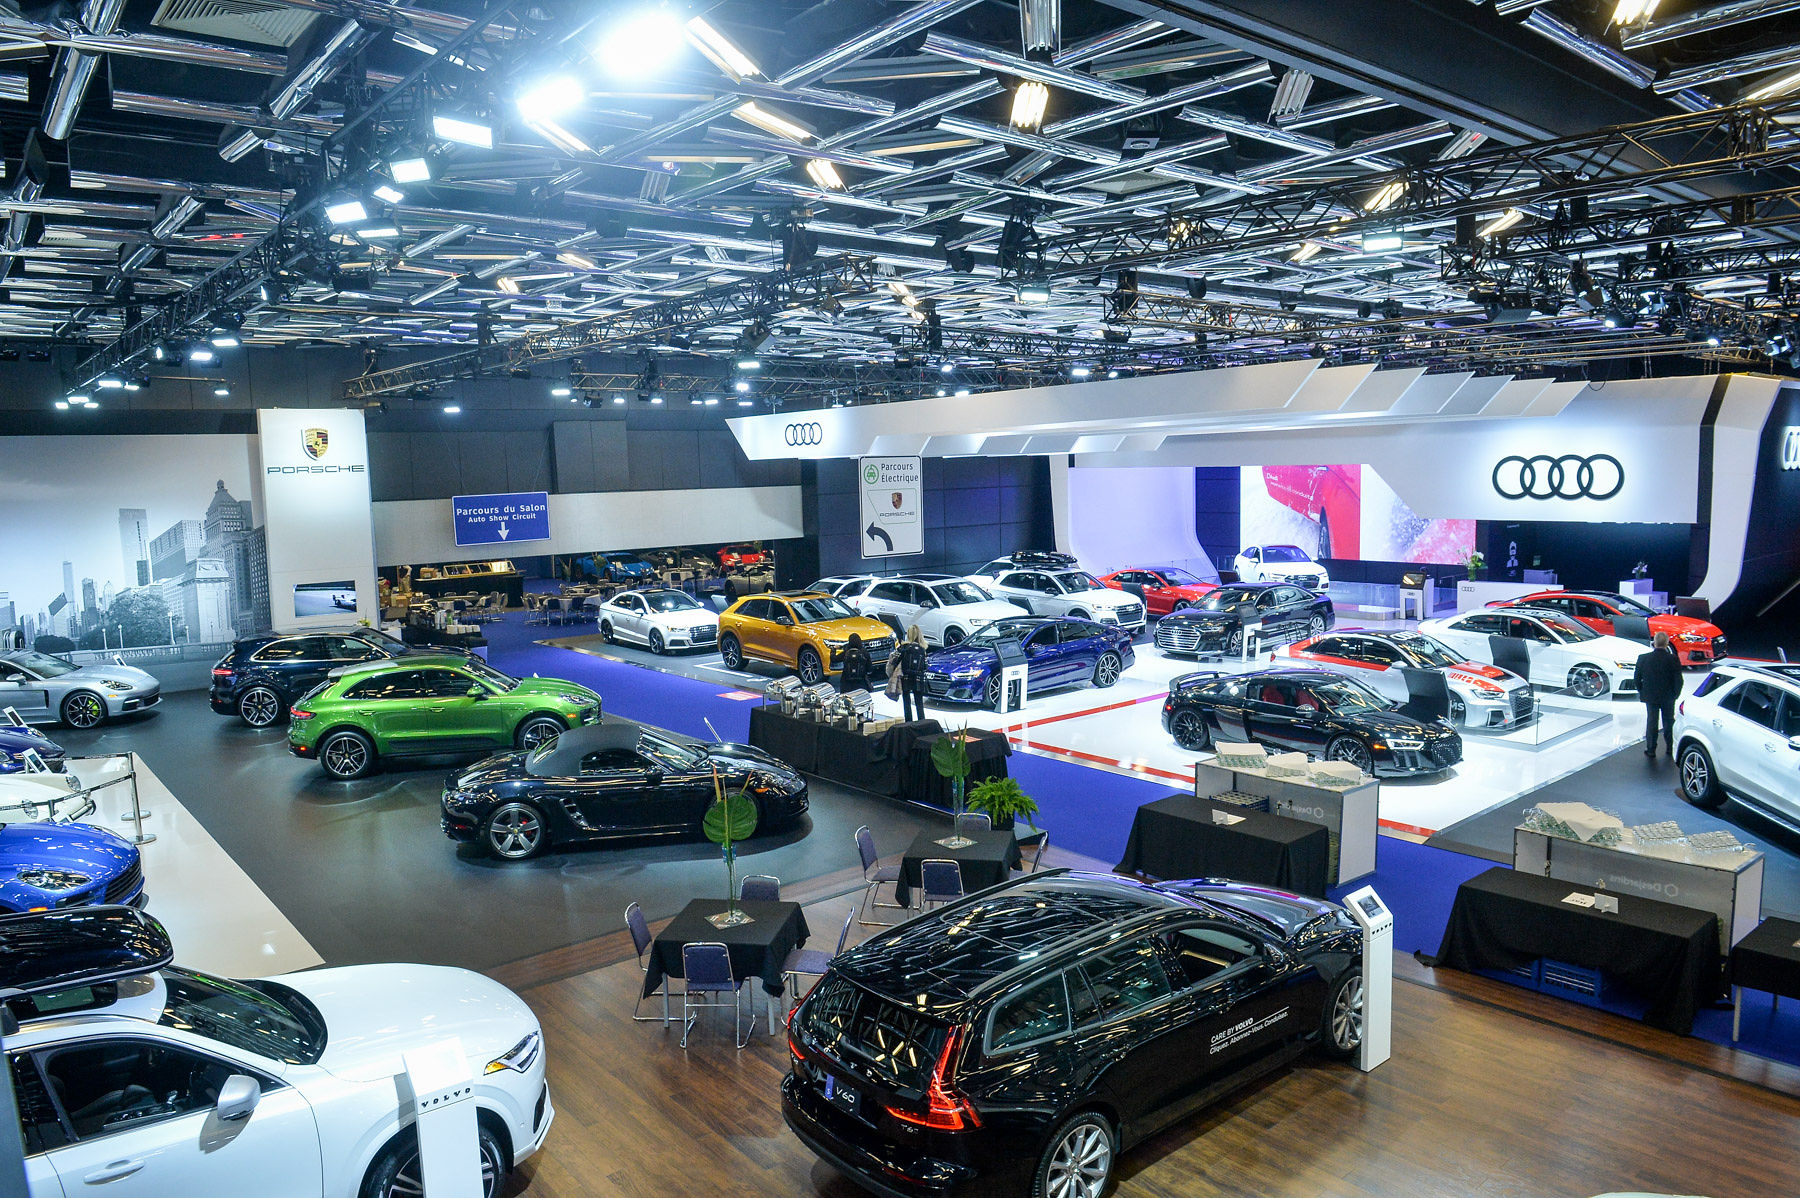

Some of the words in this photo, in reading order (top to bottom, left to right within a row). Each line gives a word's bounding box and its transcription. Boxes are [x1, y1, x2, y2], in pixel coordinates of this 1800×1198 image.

[267, 465, 365, 475] PORSCHE
[881, 463, 914, 471] Parcours
[881, 473, 919, 484] Électrique
[456, 506, 499, 516] Parcours
[503, 505, 516, 513] du
[520, 504, 546, 512] Salon
[468, 515, 486, 523] Auto
[489, 514, 509, 522] Show
[512, 512, 537, 520] Circuit
[1210, 1031, 1227, 1043] CARE
[1227, 1026, 1235, 1036] BY
[1234, 1017, 1254, 1032] VOLVO
[421, 1087, 471, 1109] VOLVO
[836, 1085, 855, 1104] V60
